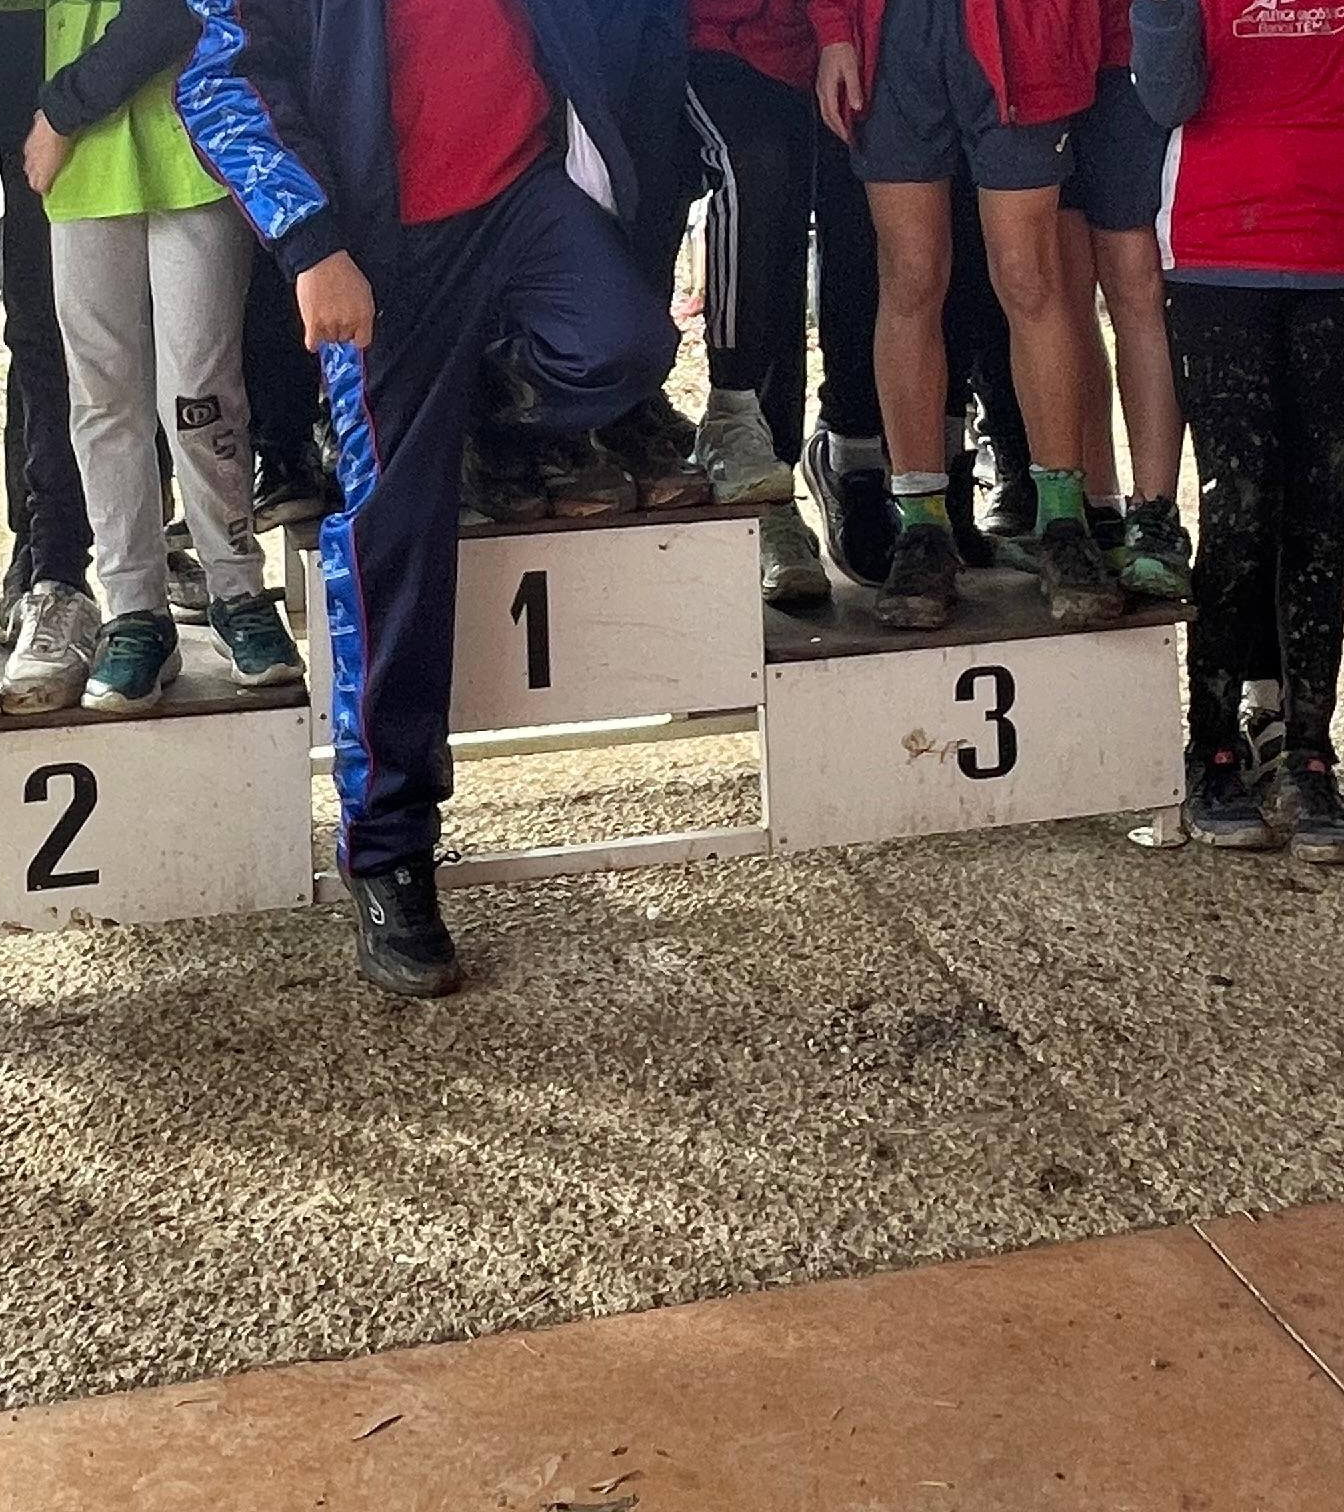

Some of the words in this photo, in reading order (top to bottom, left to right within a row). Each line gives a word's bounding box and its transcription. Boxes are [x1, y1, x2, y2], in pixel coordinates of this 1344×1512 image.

[510, 570, 552, 690] 1
[954, 665, 1018, 780] 3
[23, 762, 100, 892] 2
